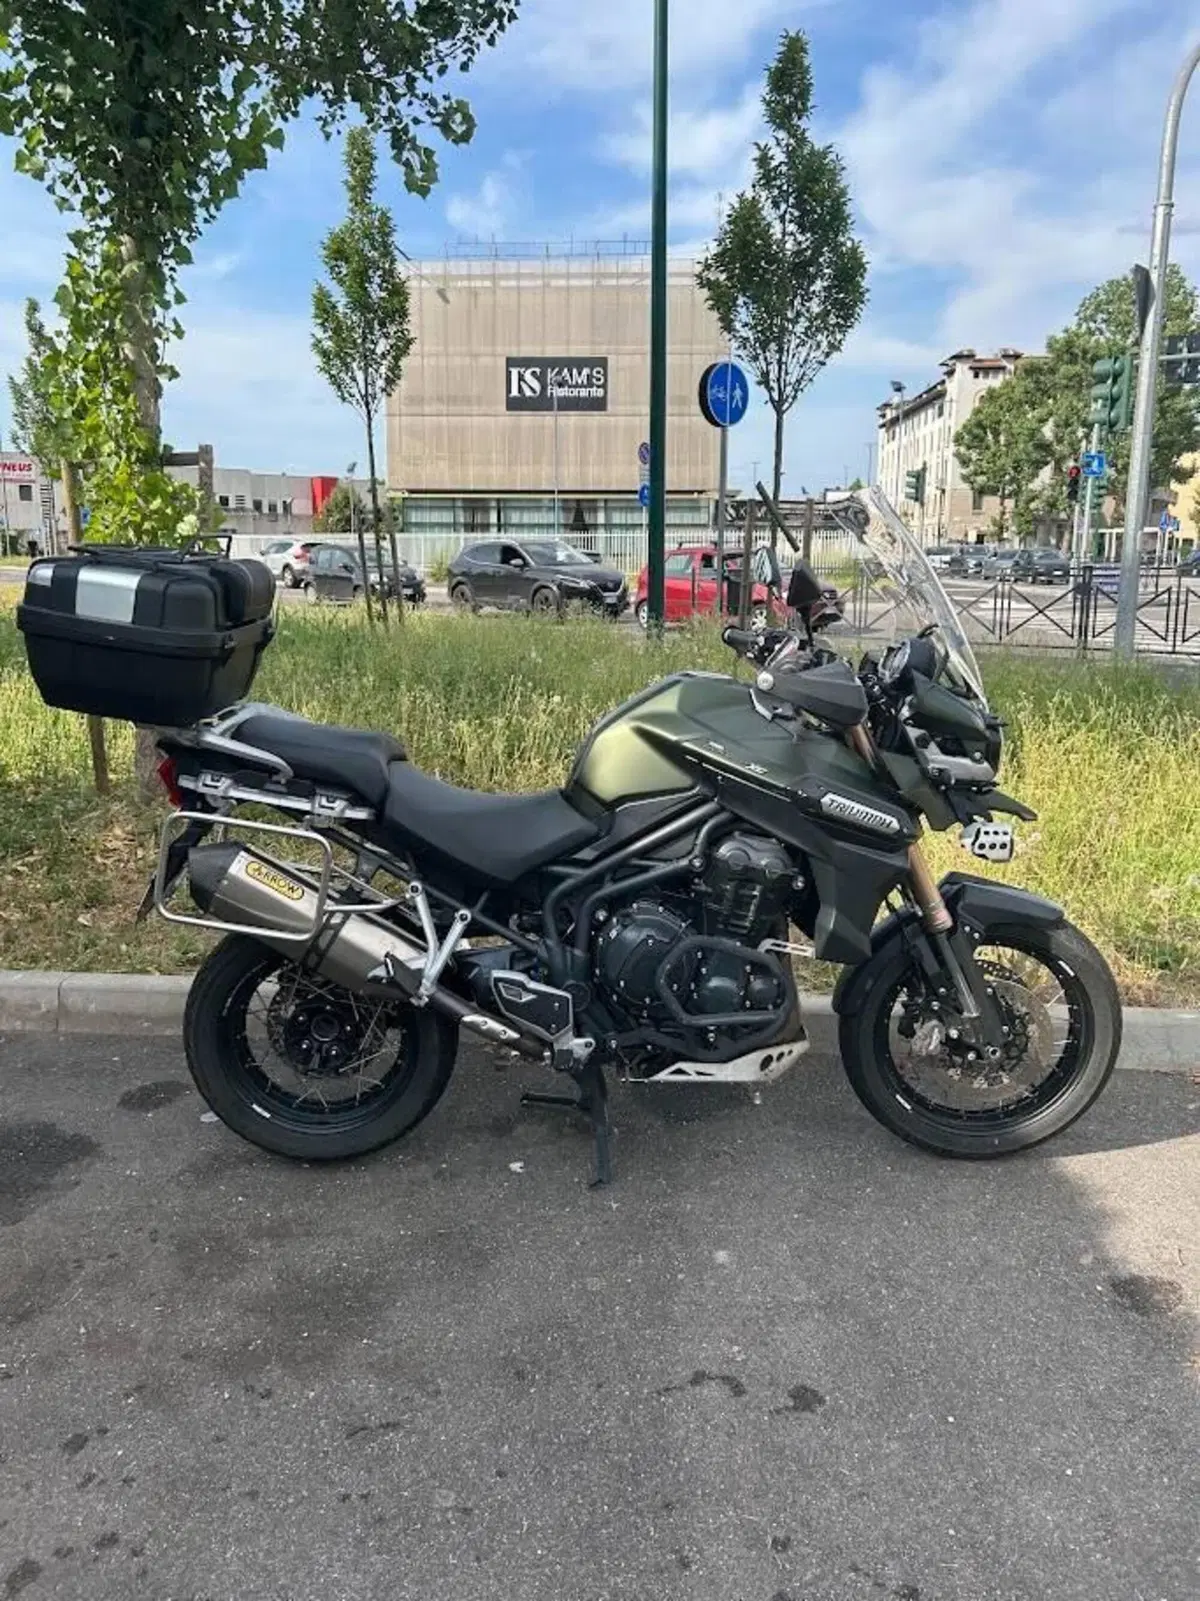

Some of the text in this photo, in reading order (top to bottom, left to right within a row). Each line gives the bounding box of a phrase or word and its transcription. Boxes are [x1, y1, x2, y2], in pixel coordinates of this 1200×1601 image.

[547, 386, 605, 398] Ristorante
[827, 796, 894, 830] TRIUMPH
[251, 863, 301, 895] ARROW
